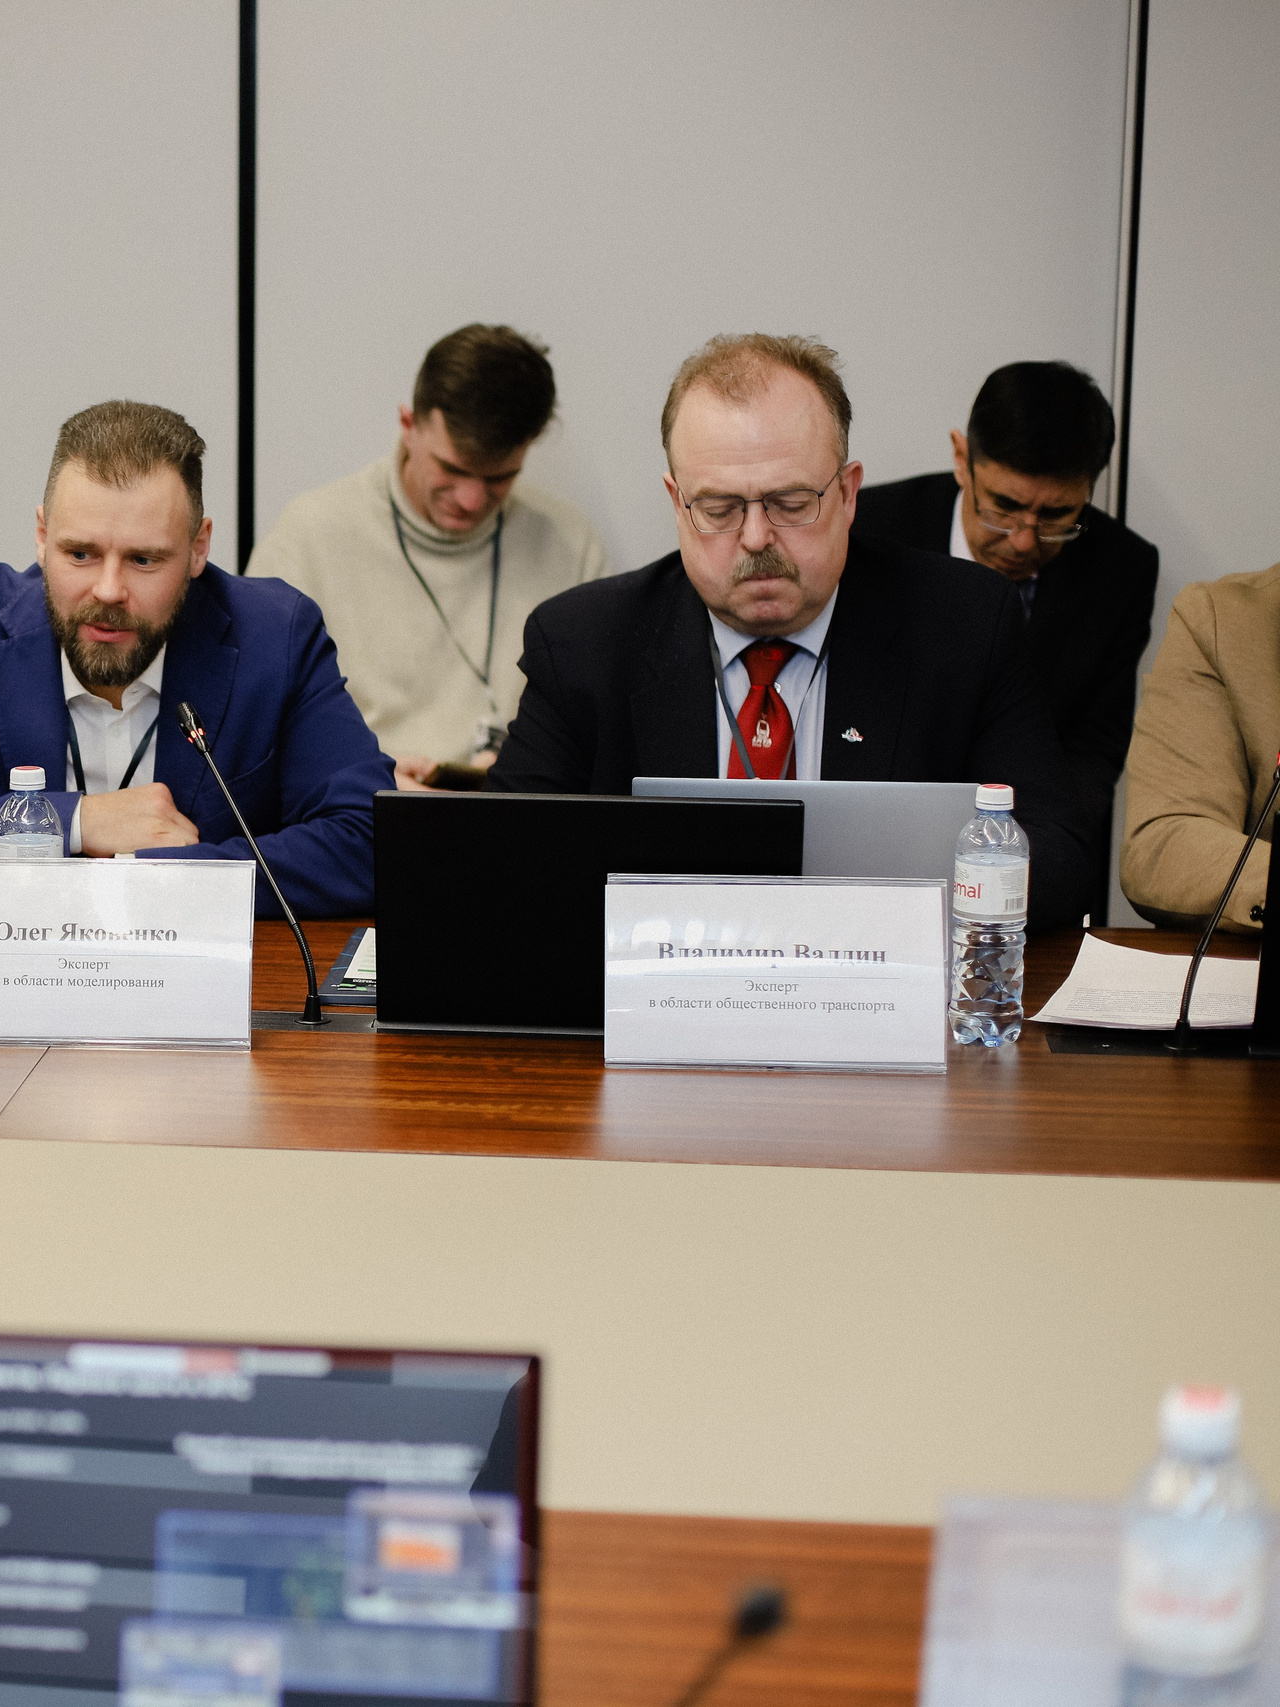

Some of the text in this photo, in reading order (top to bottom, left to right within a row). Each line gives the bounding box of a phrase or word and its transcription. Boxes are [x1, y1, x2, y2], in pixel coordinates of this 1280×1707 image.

[58, 958, 111, 972] Эксперт
[3, 975, 165, 990] в области моделирования
[744, 980, 799, 995] Эксперт
[649, 996, 895, 1013] в области общественного транспорта
